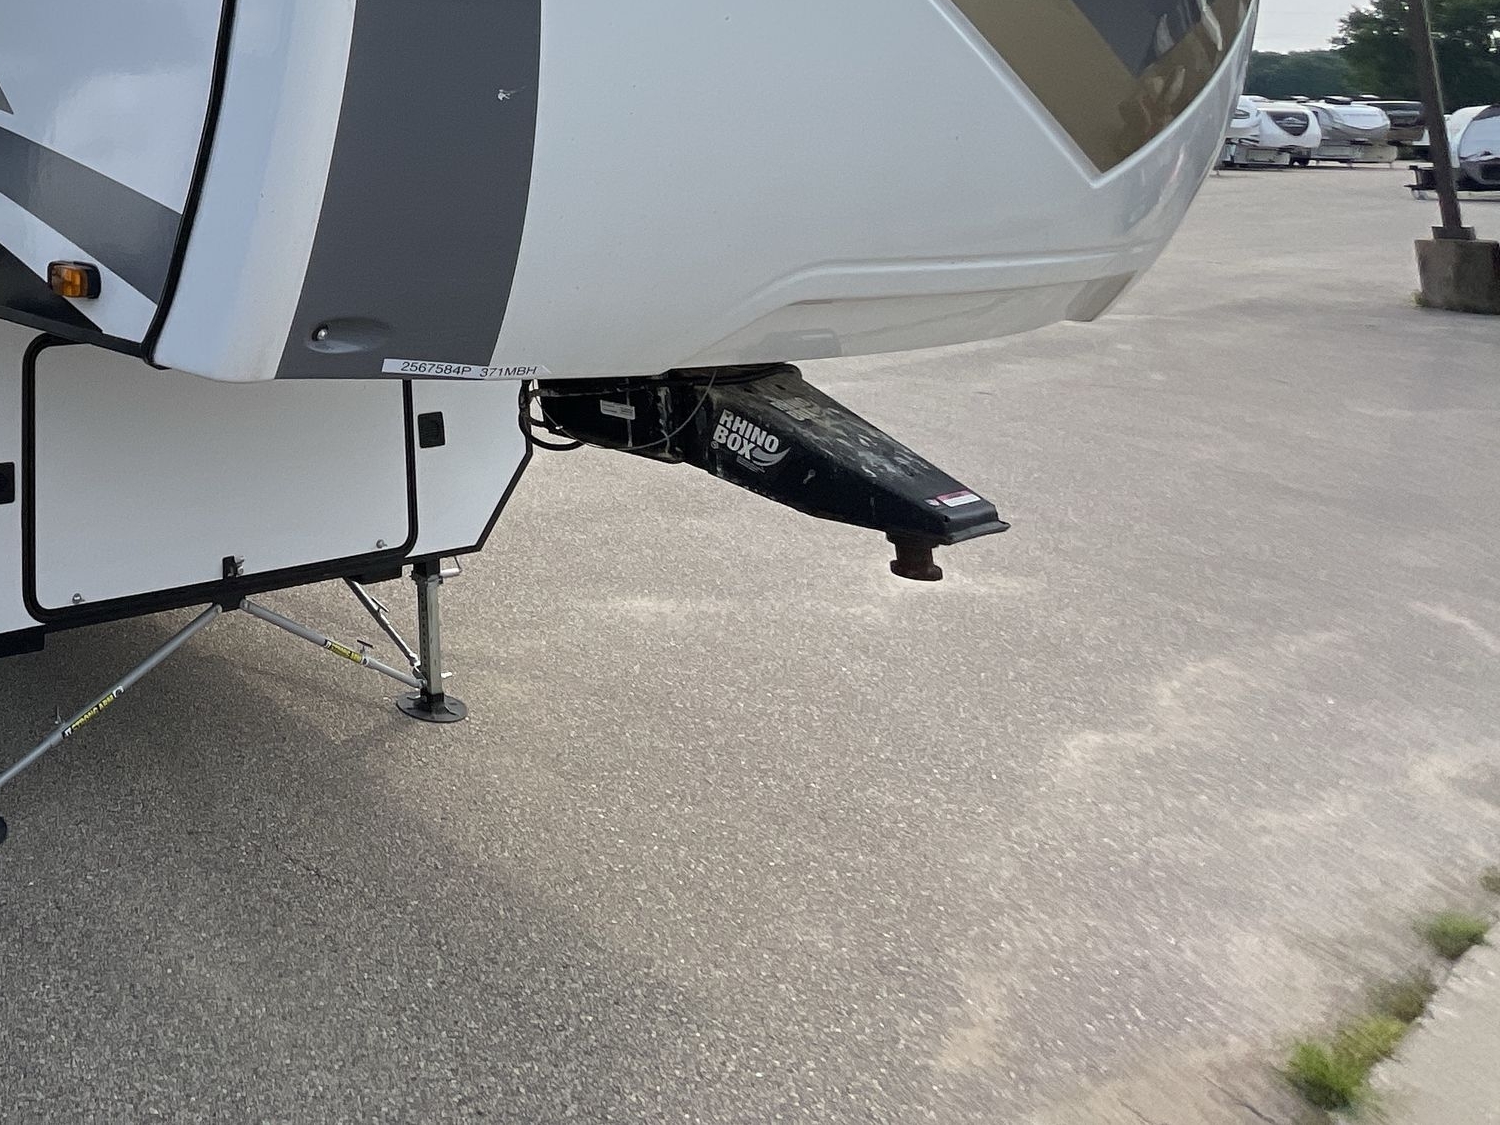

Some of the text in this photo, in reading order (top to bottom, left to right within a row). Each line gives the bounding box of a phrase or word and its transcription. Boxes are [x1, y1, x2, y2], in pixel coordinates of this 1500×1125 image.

[401, 361, 538, 378] 2567584P 371MBH
[713, 424, 756, 460] BOX
[719, 409, 780, 453] RHINO
